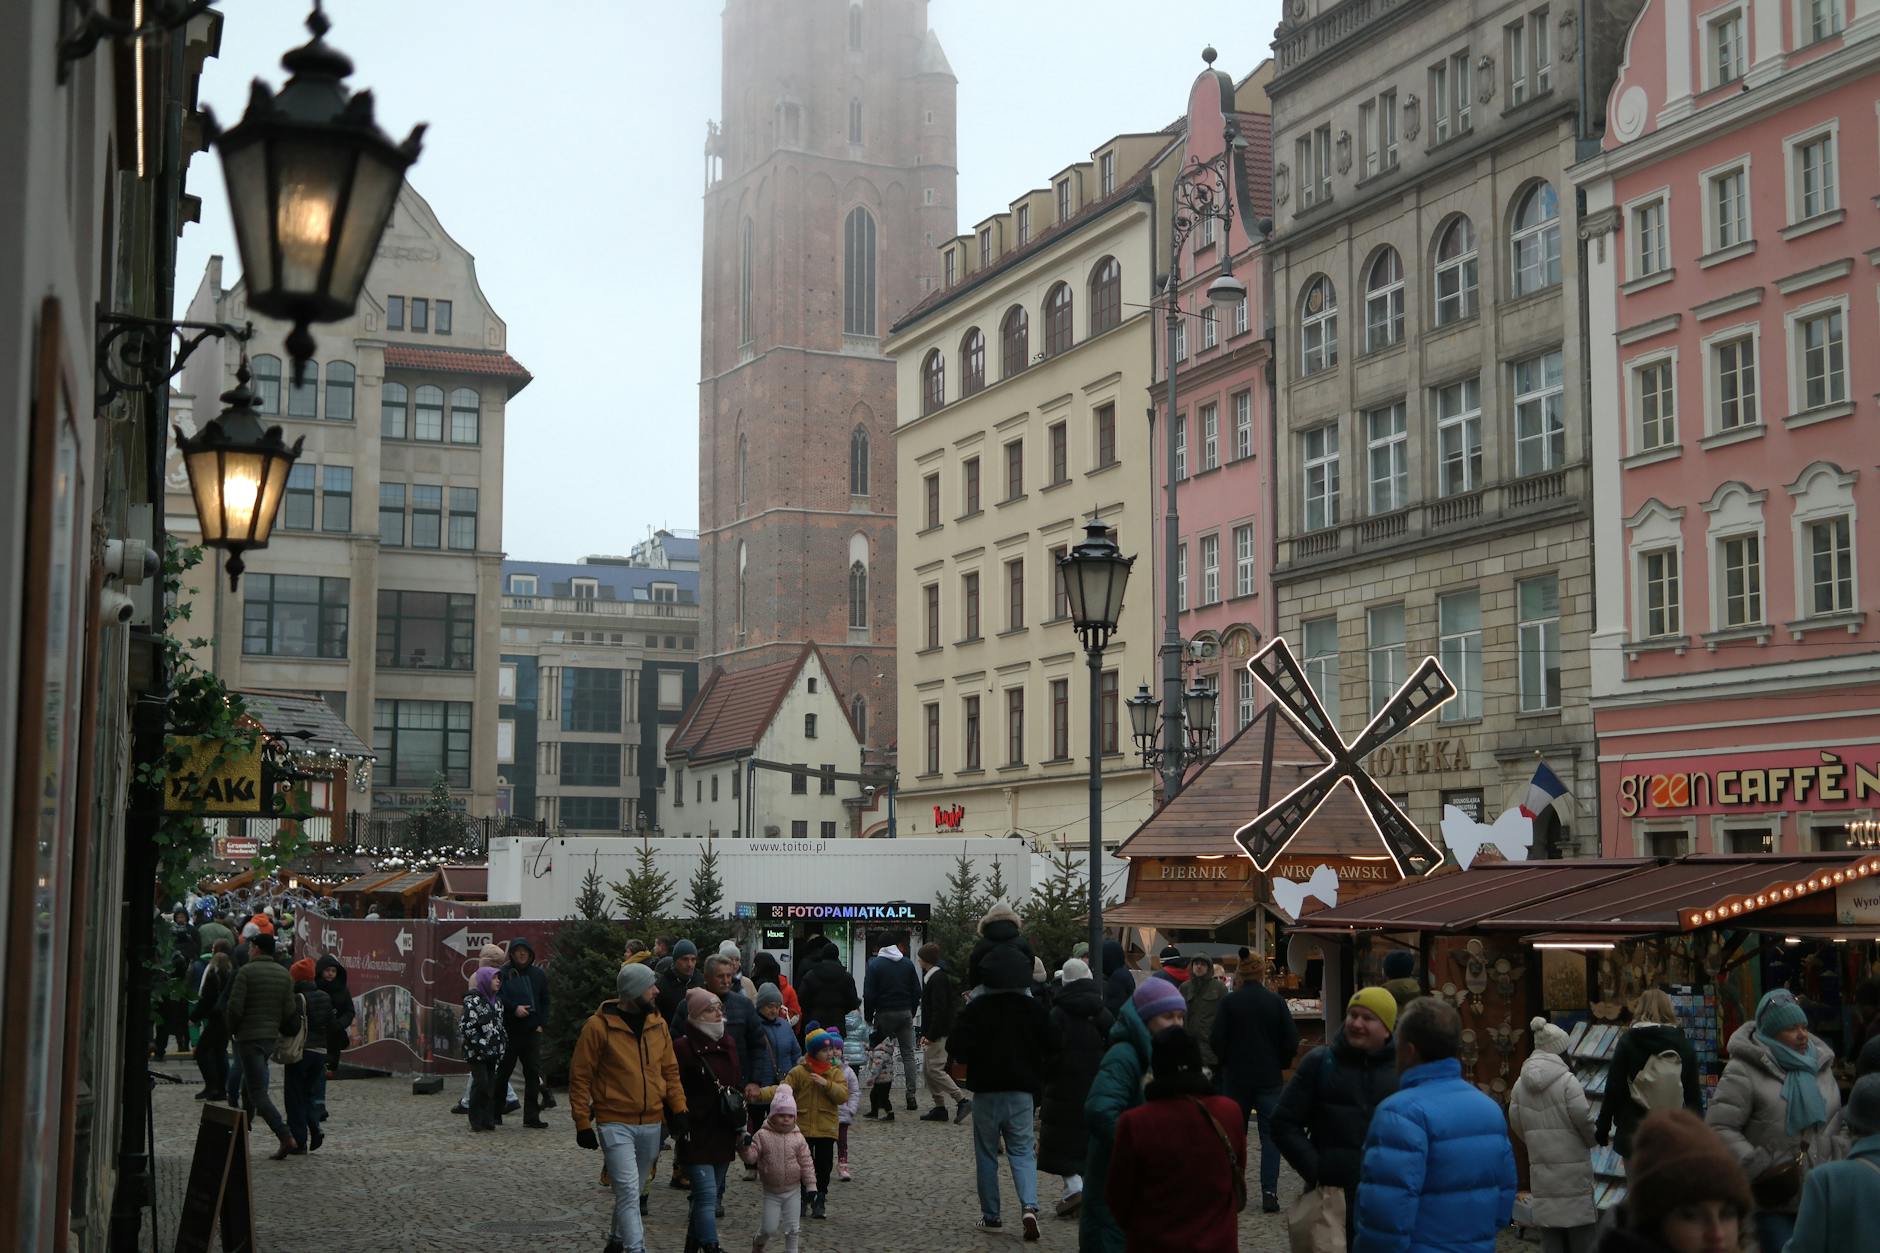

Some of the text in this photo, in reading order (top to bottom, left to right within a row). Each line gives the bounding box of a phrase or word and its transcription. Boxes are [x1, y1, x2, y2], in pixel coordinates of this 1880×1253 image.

[1367, 739, 1471, 777] IOTEKA
[1620, 771, 1711, 817] green
[1716, 751, 1847, 803] CAFFÈ
[749, 841, 826, 853] www.toitoi.pl
[1161, 865, 1388, 879] PIERNIK WROAWSKI
[1853, 896, 1880, 910] Wyro
[787, 906, 915, 919] FOTOPAMIĄTKA.PL
[402, 936, 413, 947] WC
[467, 936, 491, 947] WC
